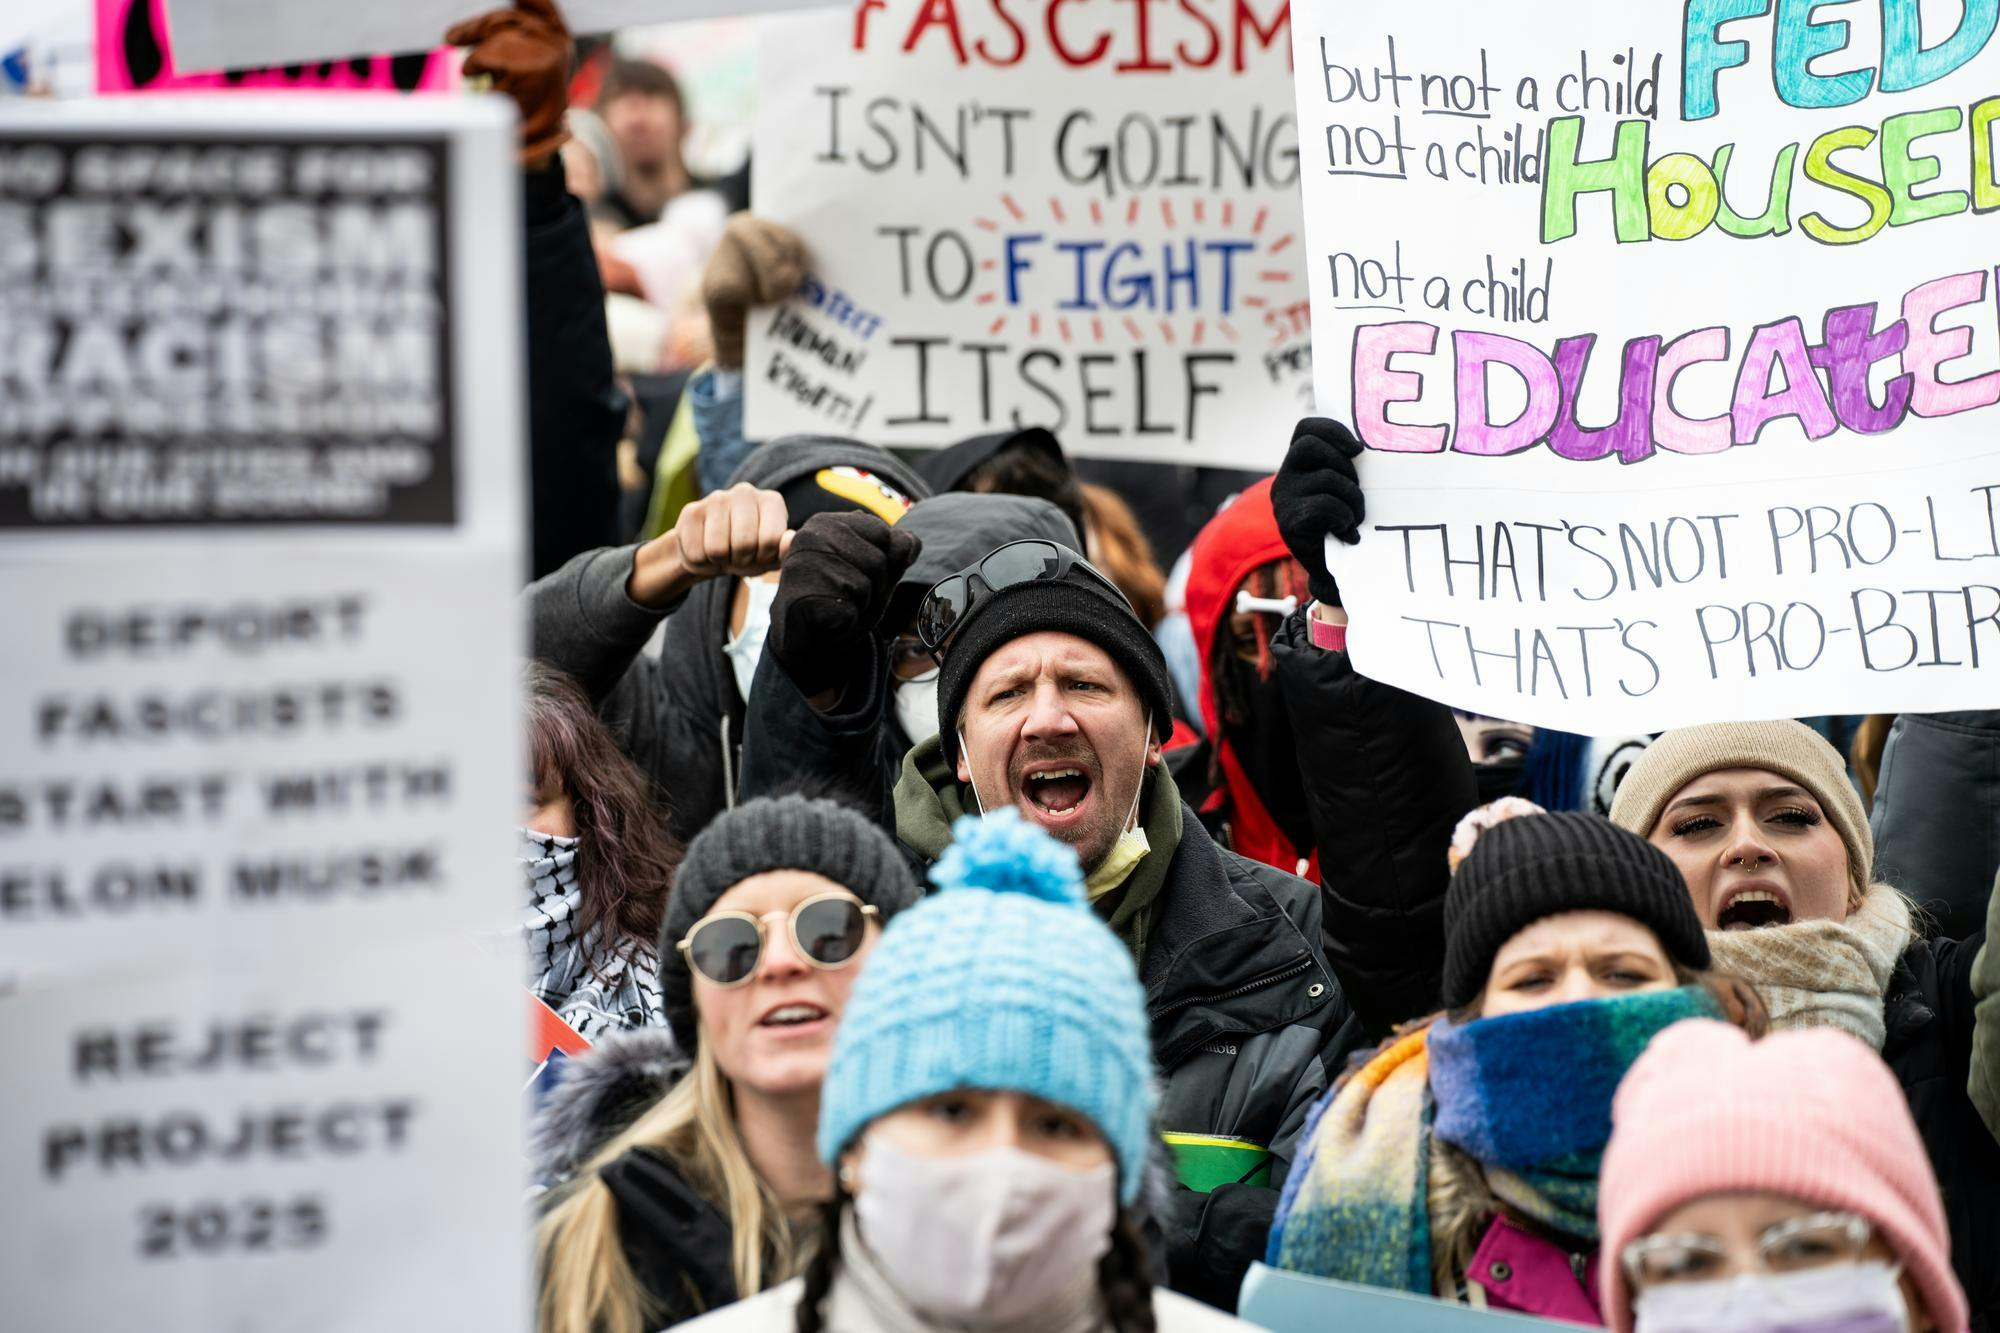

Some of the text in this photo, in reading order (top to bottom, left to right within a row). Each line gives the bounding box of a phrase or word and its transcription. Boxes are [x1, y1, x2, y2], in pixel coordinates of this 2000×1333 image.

[852, 0, 1294, 75] FASCISM
[1320, 0, 2000, 121] but not a child FED
[816, 86, 1299, 198] ISN'T GOING
[1326, 115, 1416, 174] not
[1425, 142, 1449, 181] a
[1455, 122, 1545, 184] child
[878, 227, 1257, 315] TO FIGHT
[1328, 240, 1553, 323] not a child
[884, 336, 1237, 442] ITSELF
[1374, 485, 2000, 602] THAT'S NOT PRO-LI
[64, 597, 367, 658] DEPORT
[1400, 584, 2000, 699] THAT'S PRO-BIR
[35, 683, 401, 746] FASCISTS
[0, 765, 453, 829] START WITH
[0, 848, 443, 918] ELON MUSK
[71, 1013, 386, 1084] REJECT
[40, 1102, 416, 1181] PROJECT
[137, 1201, 329, 1260] 2025
